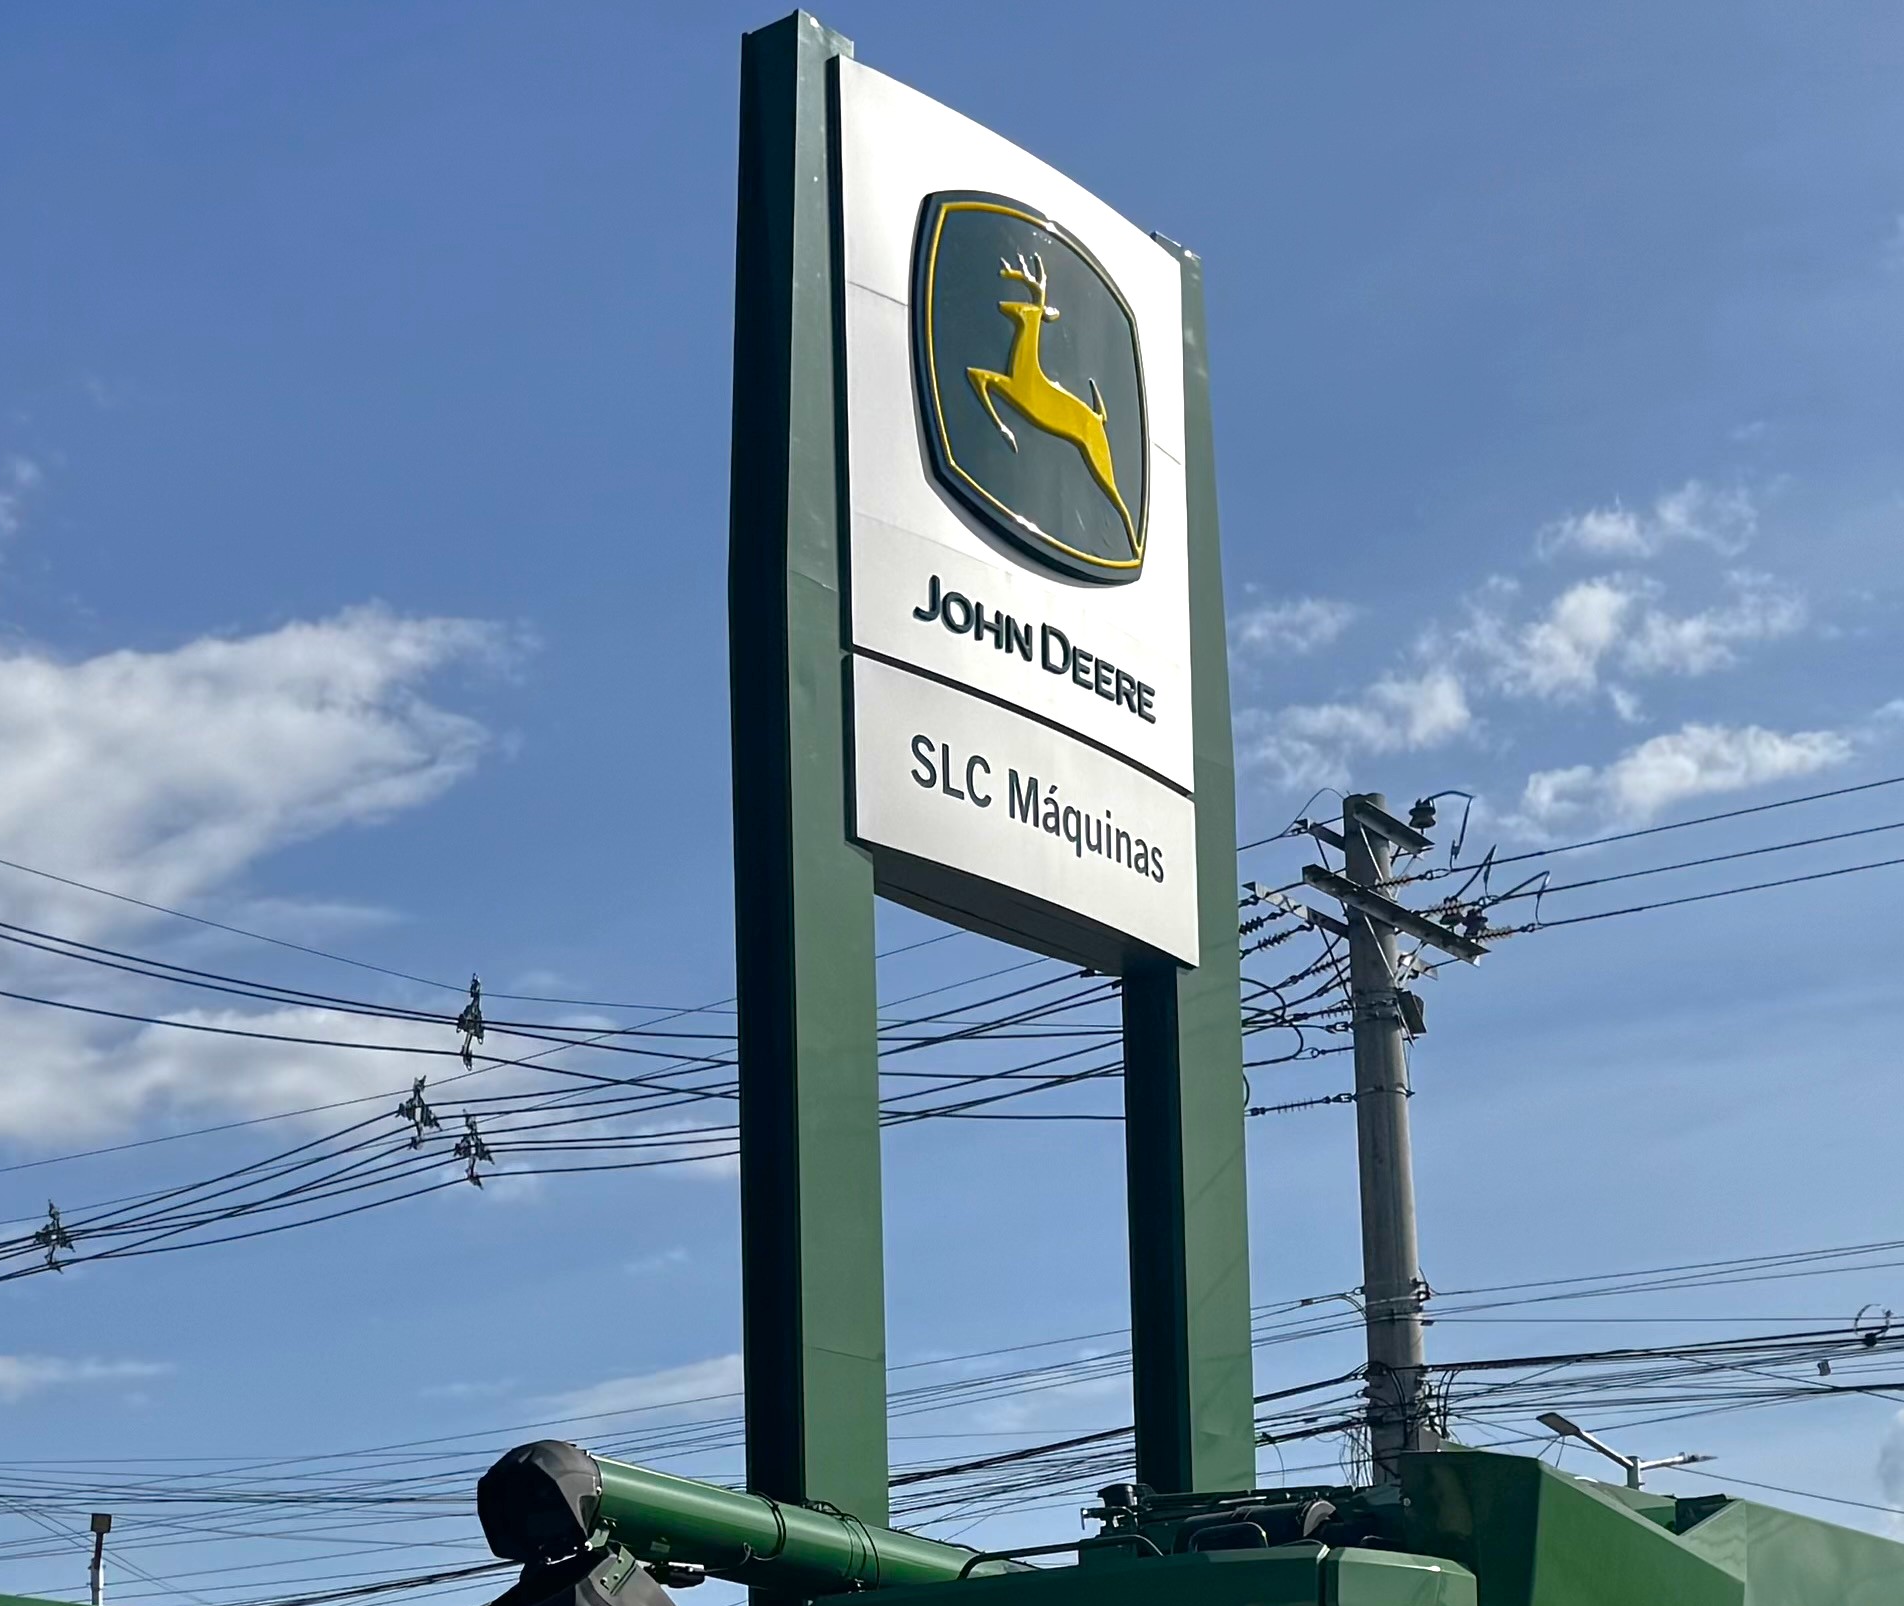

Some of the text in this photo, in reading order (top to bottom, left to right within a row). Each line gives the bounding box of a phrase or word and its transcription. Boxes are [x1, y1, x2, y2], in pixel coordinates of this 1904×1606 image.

[912, 574, 1157, 725] JOHN DEERE
[910, 734, 1165, 883] SLC Máquinas
